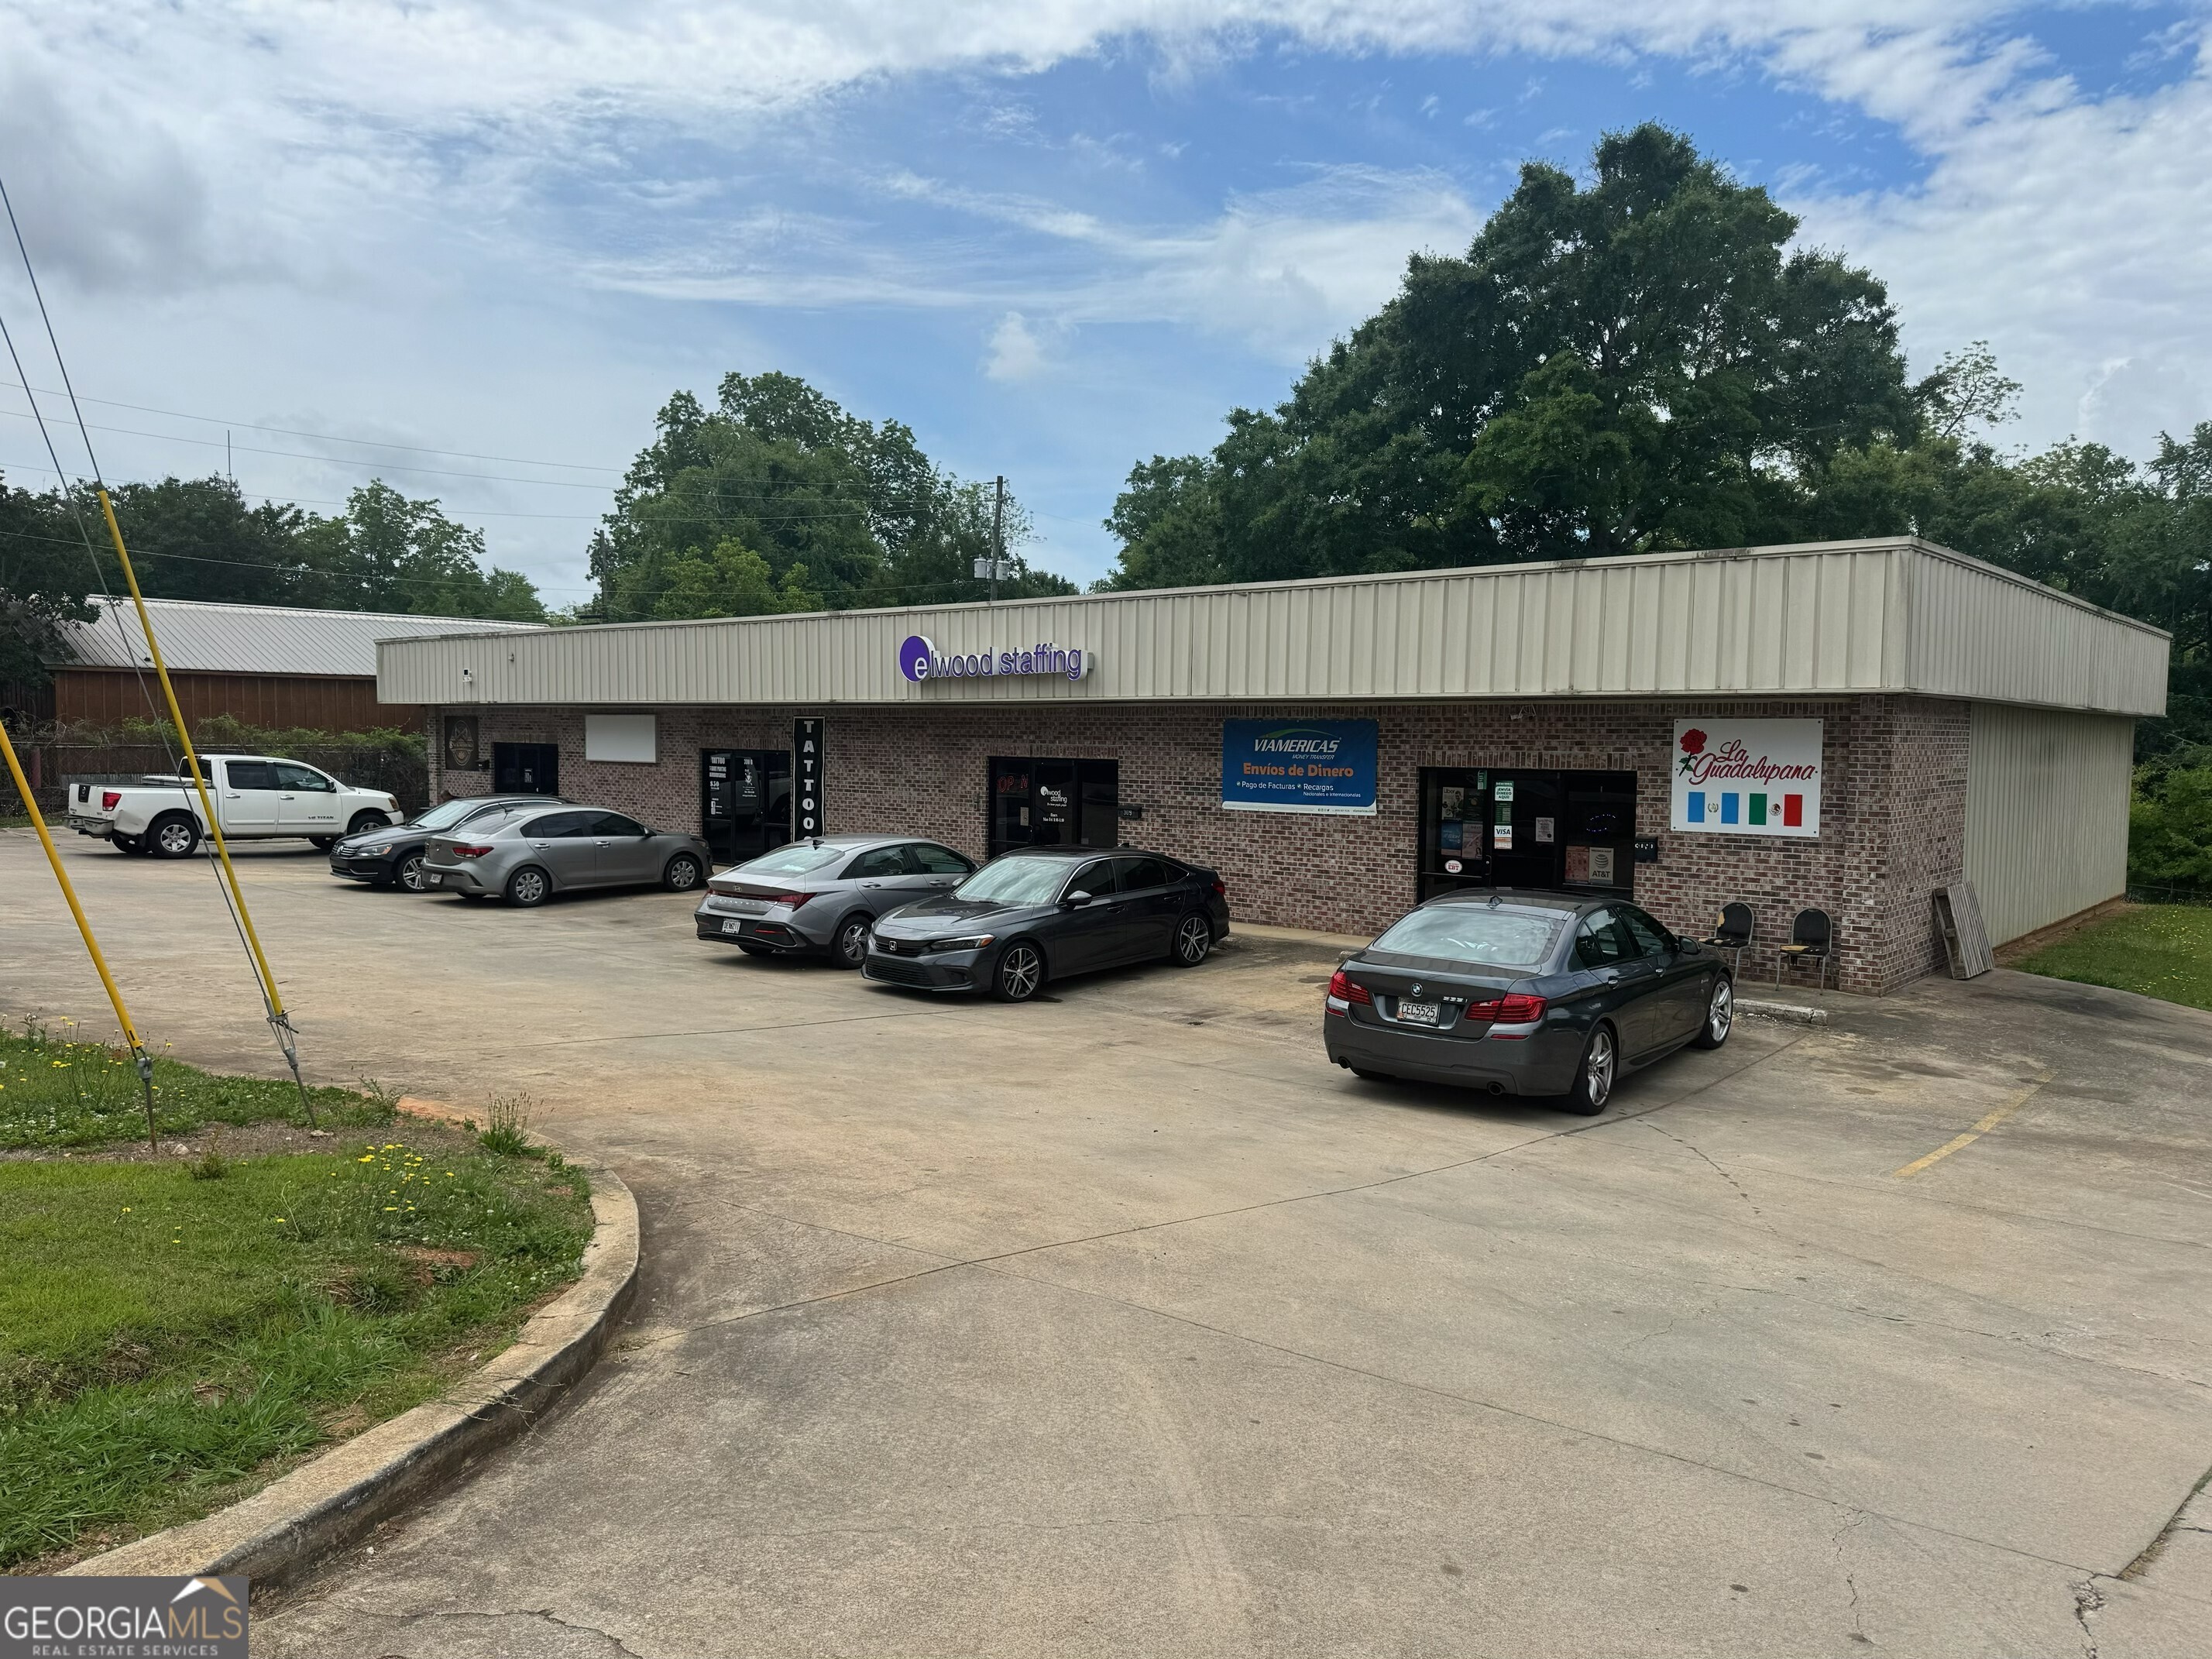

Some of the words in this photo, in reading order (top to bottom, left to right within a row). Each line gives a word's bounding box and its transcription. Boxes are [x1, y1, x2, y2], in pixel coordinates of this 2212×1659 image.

[913, 646, 993, 680] elwood
[999, 642, 1082, 681] staffing
[1254, 739, 1340, 753] VIAMERICAS
[1715, 739, 1747, 763] La
[1243, 762, 1285, 776] Envíos
[1288, 764, 1304, 776] de
[1307, 764, 1354, 777] Dinero
[1688, 752, 1815, 785] Guadalupana
[802, 720, 815, 840] TATTOO
[1242, 781, 1257, 790] Pago
[1268, 781, 1296, 790] Facturas
[1304, 783, 1334, 792] Recargas
[1592, 870, 1611, 878] AT&T
[1402, 1003, 1436, 1018] CEC5525
